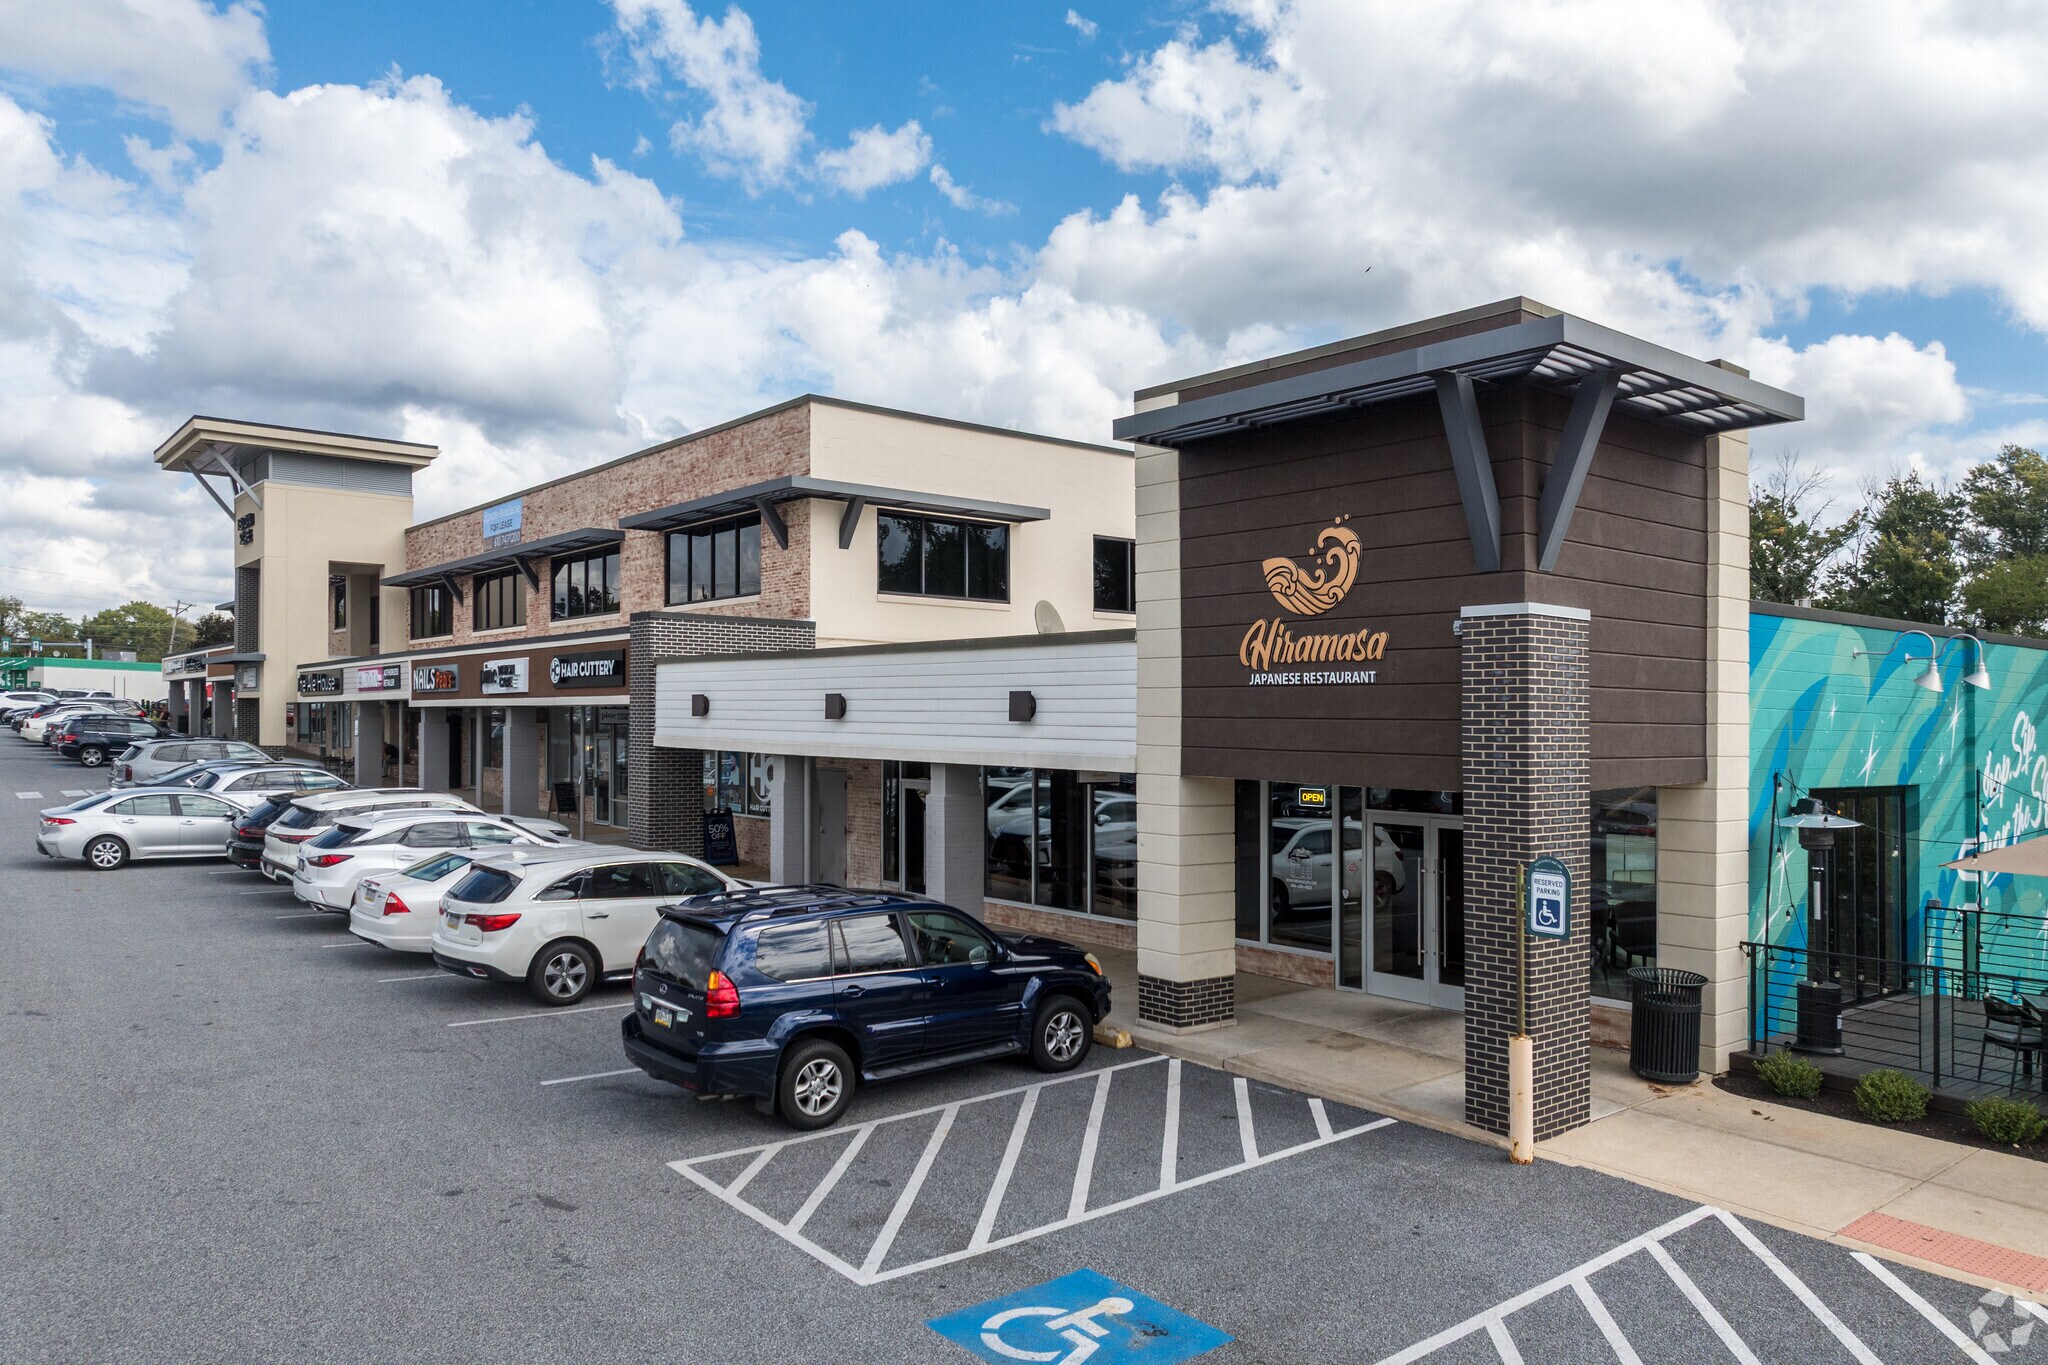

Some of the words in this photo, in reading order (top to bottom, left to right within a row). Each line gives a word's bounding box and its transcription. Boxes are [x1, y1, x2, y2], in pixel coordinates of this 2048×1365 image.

[1240, 617, 1389, 672] Hiramasa
[561, 662, 578, 678] HAIR
[579, 659, 615, 677] CUTTERY
[317, 674, 336, 691] House
[413, 668, 436, 690] NAILS
[1249, 672, 1301, 686] JAPANESE
[1303, 671, 1377, 685] RESTAURANT
[1302, 792, 1324, 802] OPEN
[708, 823, 729, 834] 50%
[711, 832, 727, 840] OFF
[1534, 878, 1563, 888] RESERVED
[1536, 887, 1560, 896] PARKING
